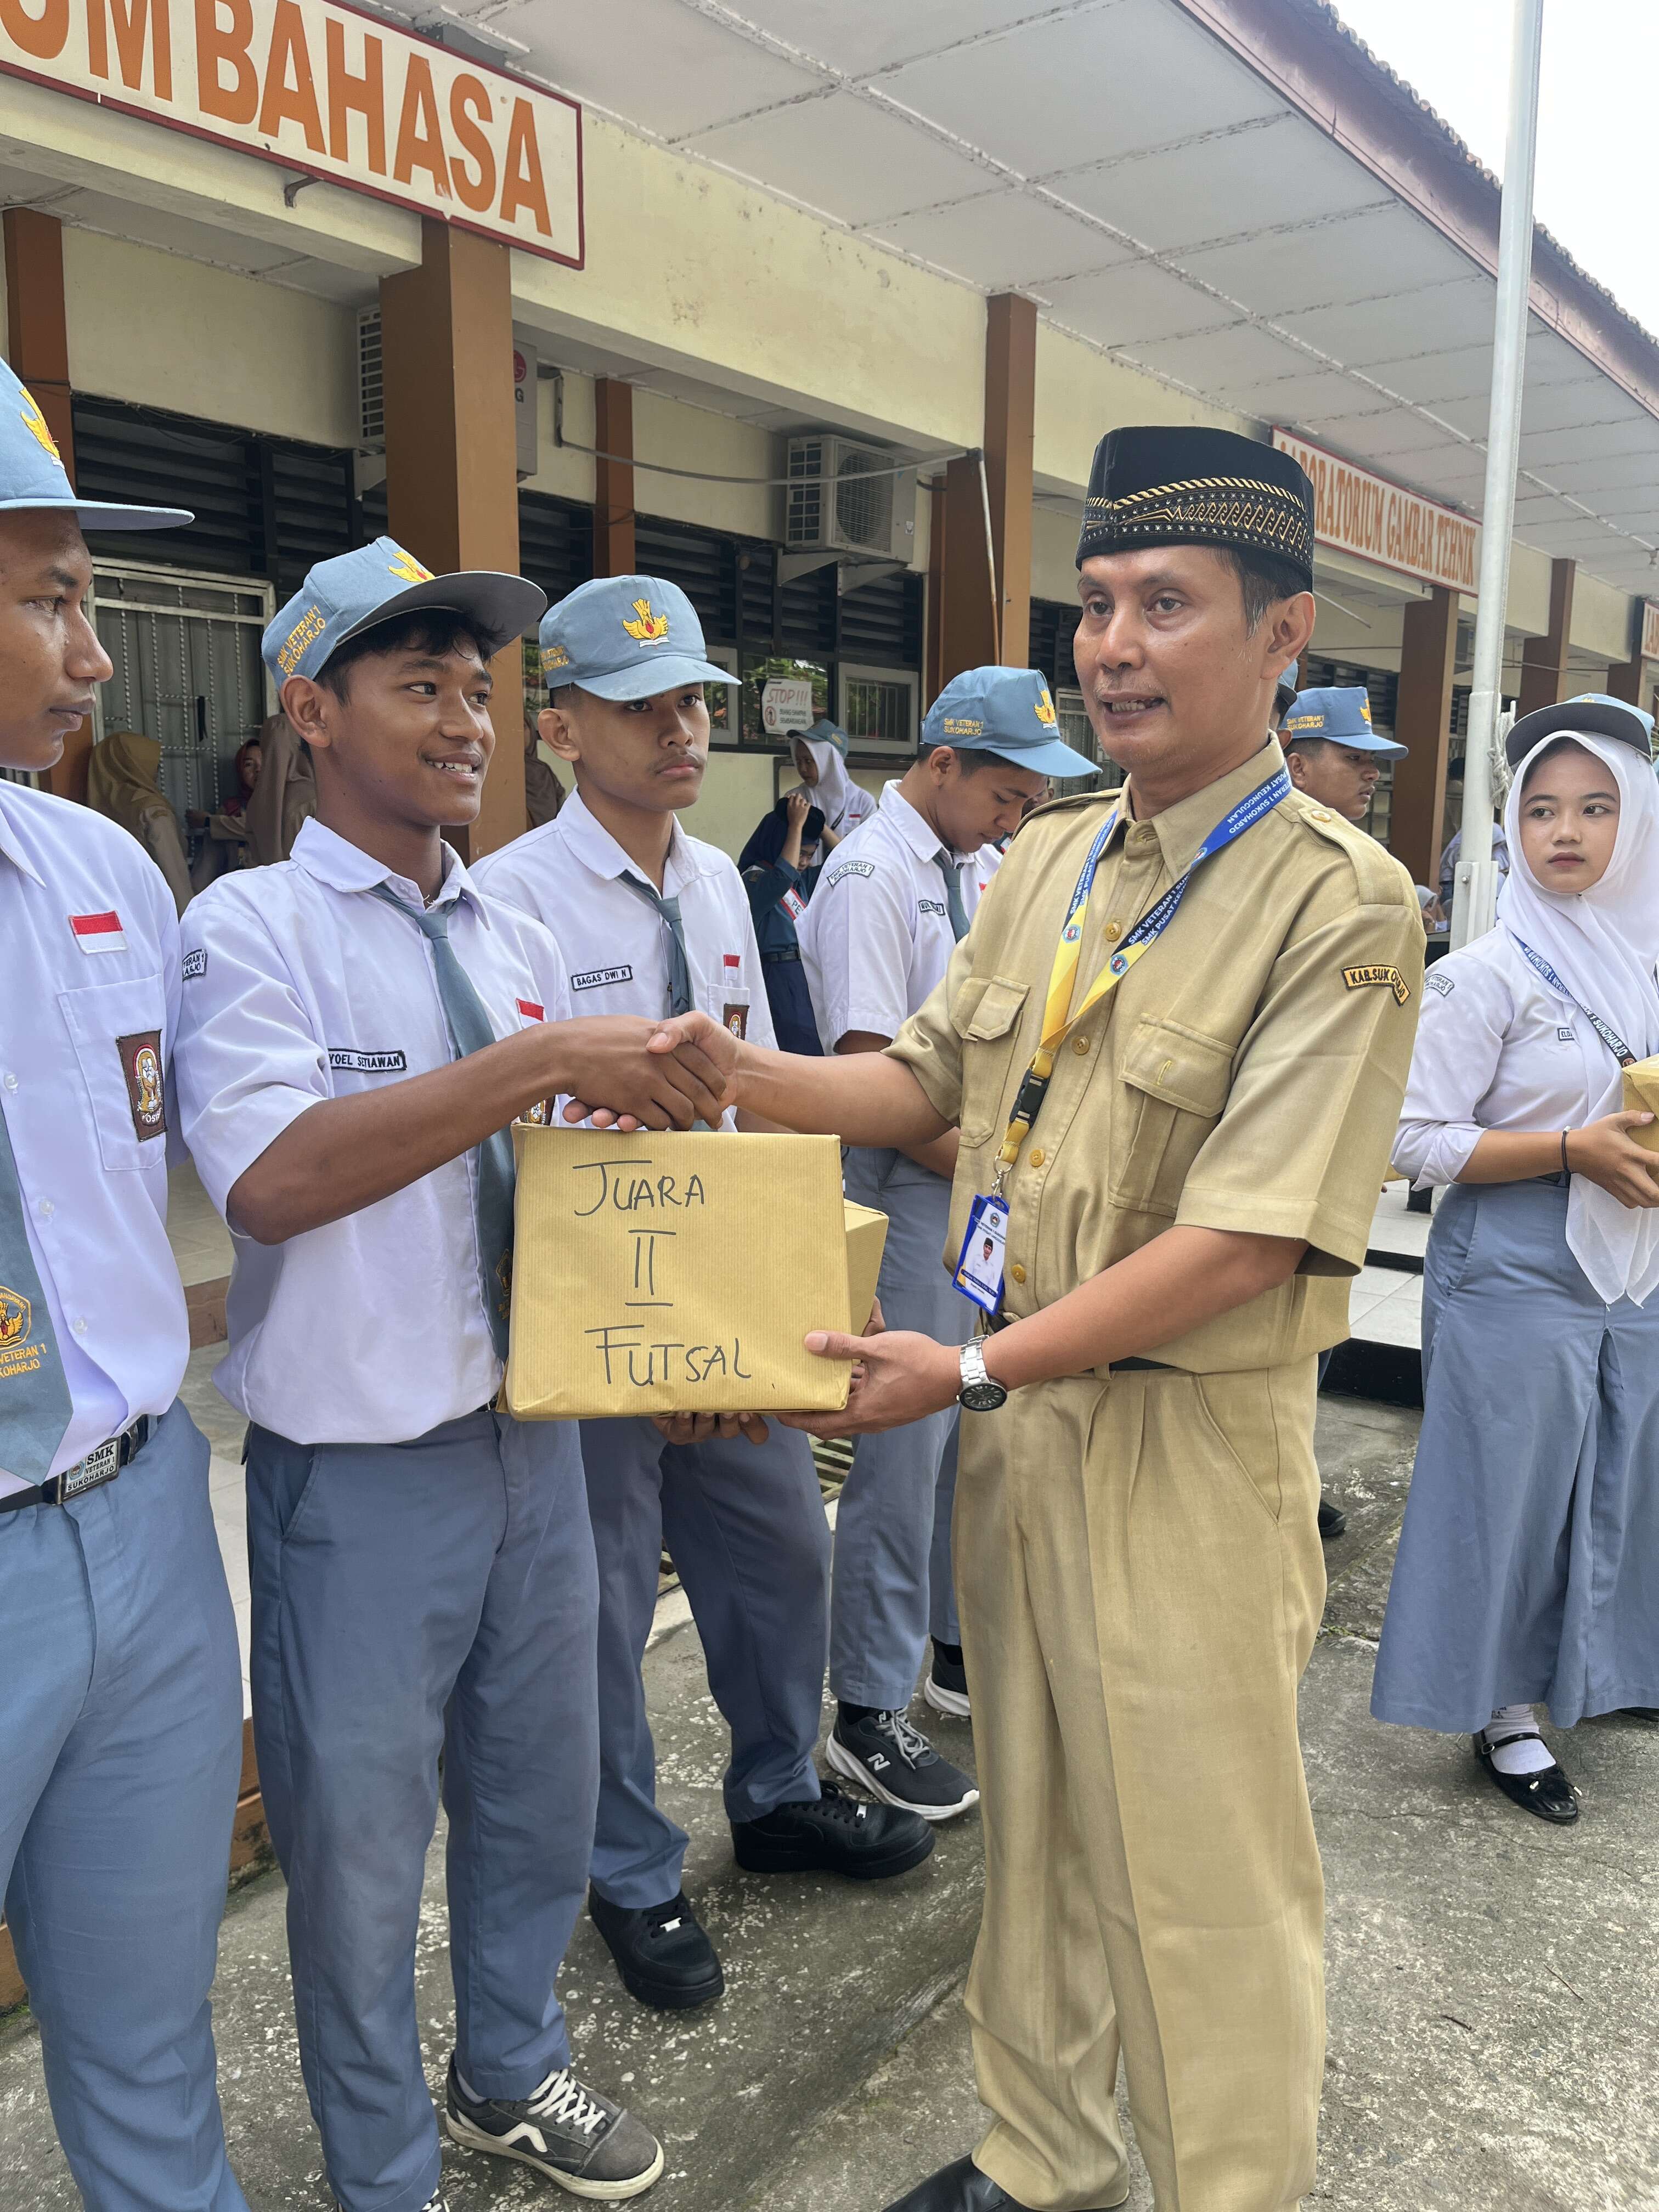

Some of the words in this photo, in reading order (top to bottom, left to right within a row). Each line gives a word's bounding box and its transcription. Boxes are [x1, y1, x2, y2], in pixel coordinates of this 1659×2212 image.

[195, 0, 552, 237] BAHASA
[1387, 492, 1434, 573] GAMBAR
[1436, 514, 1476, 586] TEHNIK
[277, 646, 289, 668] SMK
[285, 610, 316, 649] VETERAN
[313, 605, 321, 614] 1
[284, 618, 325, 676] SUKOHARJO
[944, 726, 982, 736] SUKOHARJO
[956, 719, 979, 728] VETERAN
[1288, 721, 1323, 730] SUKOHARJO
[1227, 785, 1272, 823] KEUNGGULAN
[1272, 782, 1290, 799] TERAN
[1229, 799, 1270, 834] SUKOHARJO
[1070, 896, 1080, 915] SMK
[1076, 862, 1090, 896] VETERAN
[1079, 889, 1088, 906] SMK
[1084, 865, 1092, 889] PUSAT
[792, 900, 804, 915] PE
[1128, 927, 1145, 945] SMK
[1142, 894, 1173, 928] VETERAN
[1141, 930, 1158, 945] SMK
[1155, 905, 1175, 929] PUSAT
[182, 963, 201, 976] ARJO
[577, 974, 602, 986] BAGAS
[605, 970, 619, 980] DWI
[622, 969, 627, 978] N
[1551, 977, 1571, 997] TERAN
[1593, 1019, 1628, 1057] SUKOHARJO
[329, 1053, 353, 1065] YOEL
[357, 1056, 400, 1068] SETIAWAN
[572, 1160, 705, 1216] JUARA
[624, 1229, 677, 1307] II
[41, 1343, 47, 1355] 1
[584, 1324, 752, 1387] FUTSAL
[86, 1459, 111, 1474] VETERAN
[87, 1444, 114, 1465] SMK
[67, 1465, 114, 1491] SUKOHARJO
